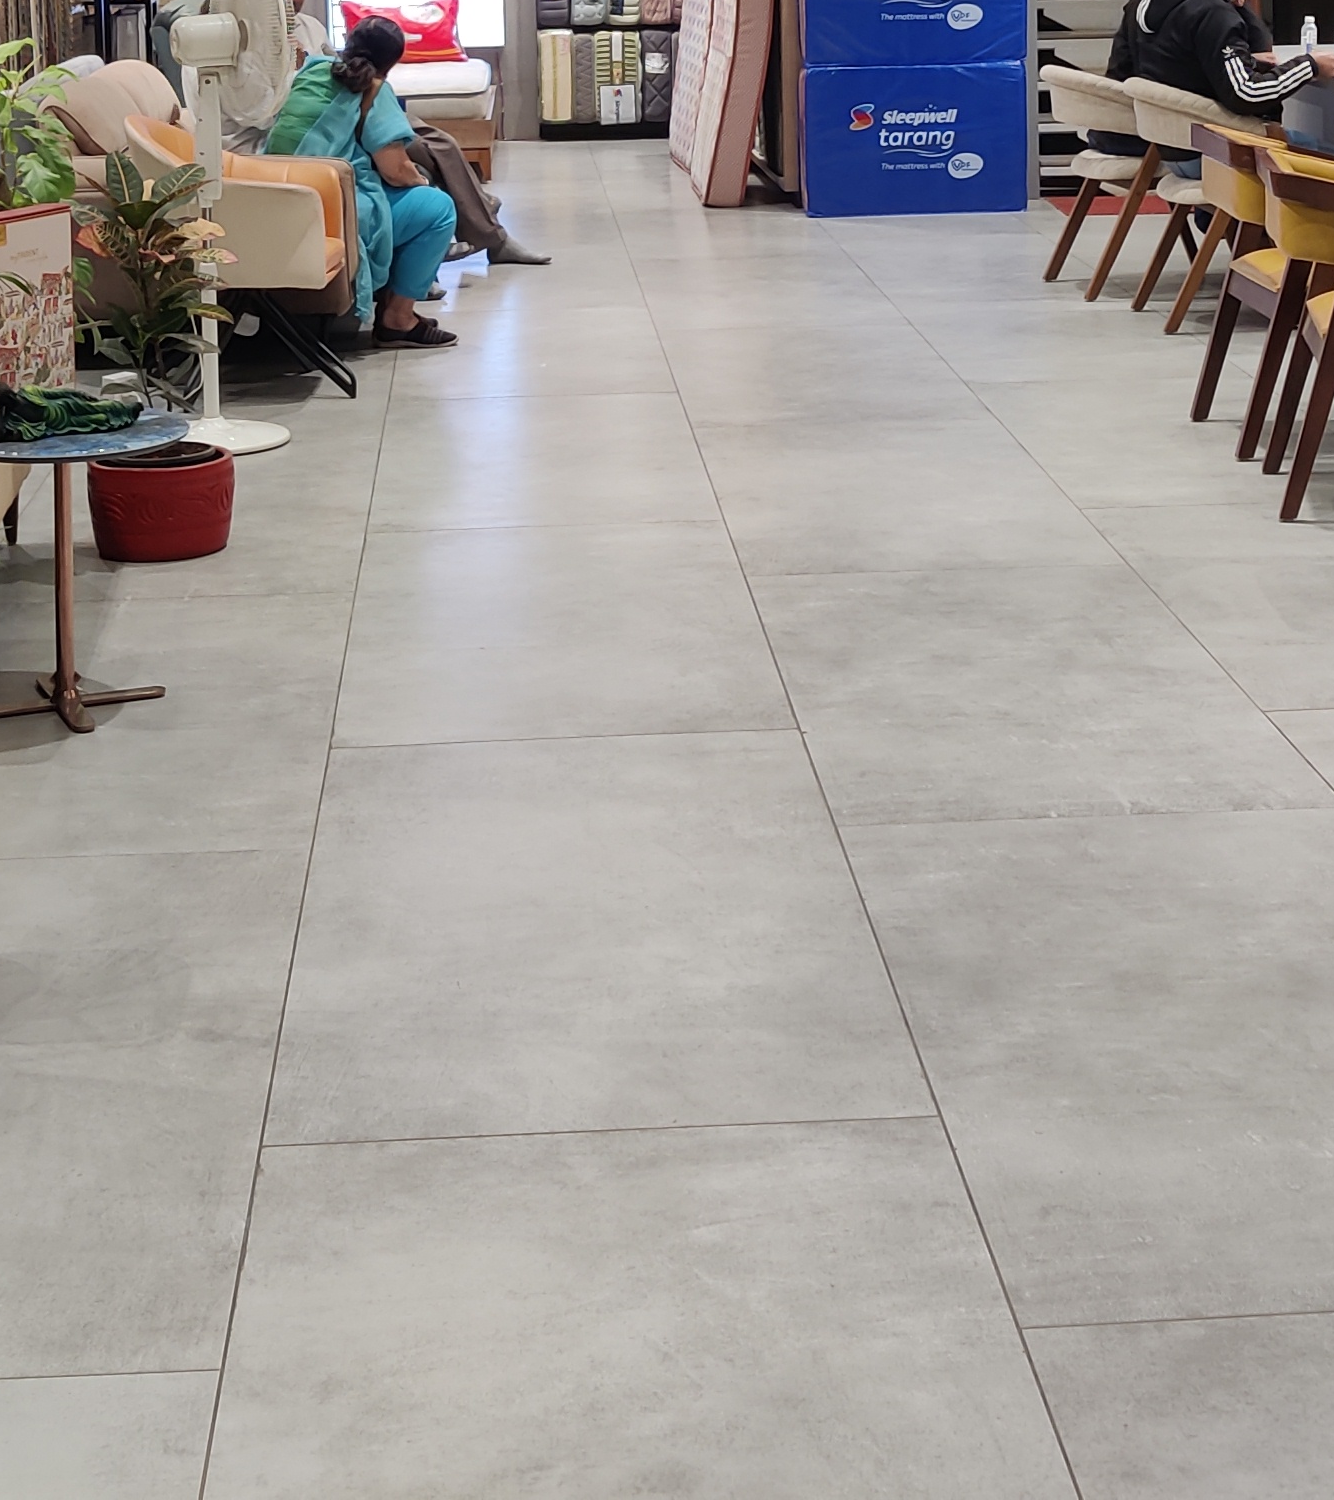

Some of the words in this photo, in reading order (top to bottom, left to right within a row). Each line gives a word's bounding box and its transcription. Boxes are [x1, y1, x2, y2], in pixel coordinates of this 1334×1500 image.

[880, 13, 894, 21] The
[928, 12, 945, 20] with
[881, 108, 958, 126] Sleepwell
[878, 128, 955, 150] tarang
[881, 162, 895, 171] The
[895, 162, 928, 170] mattress
